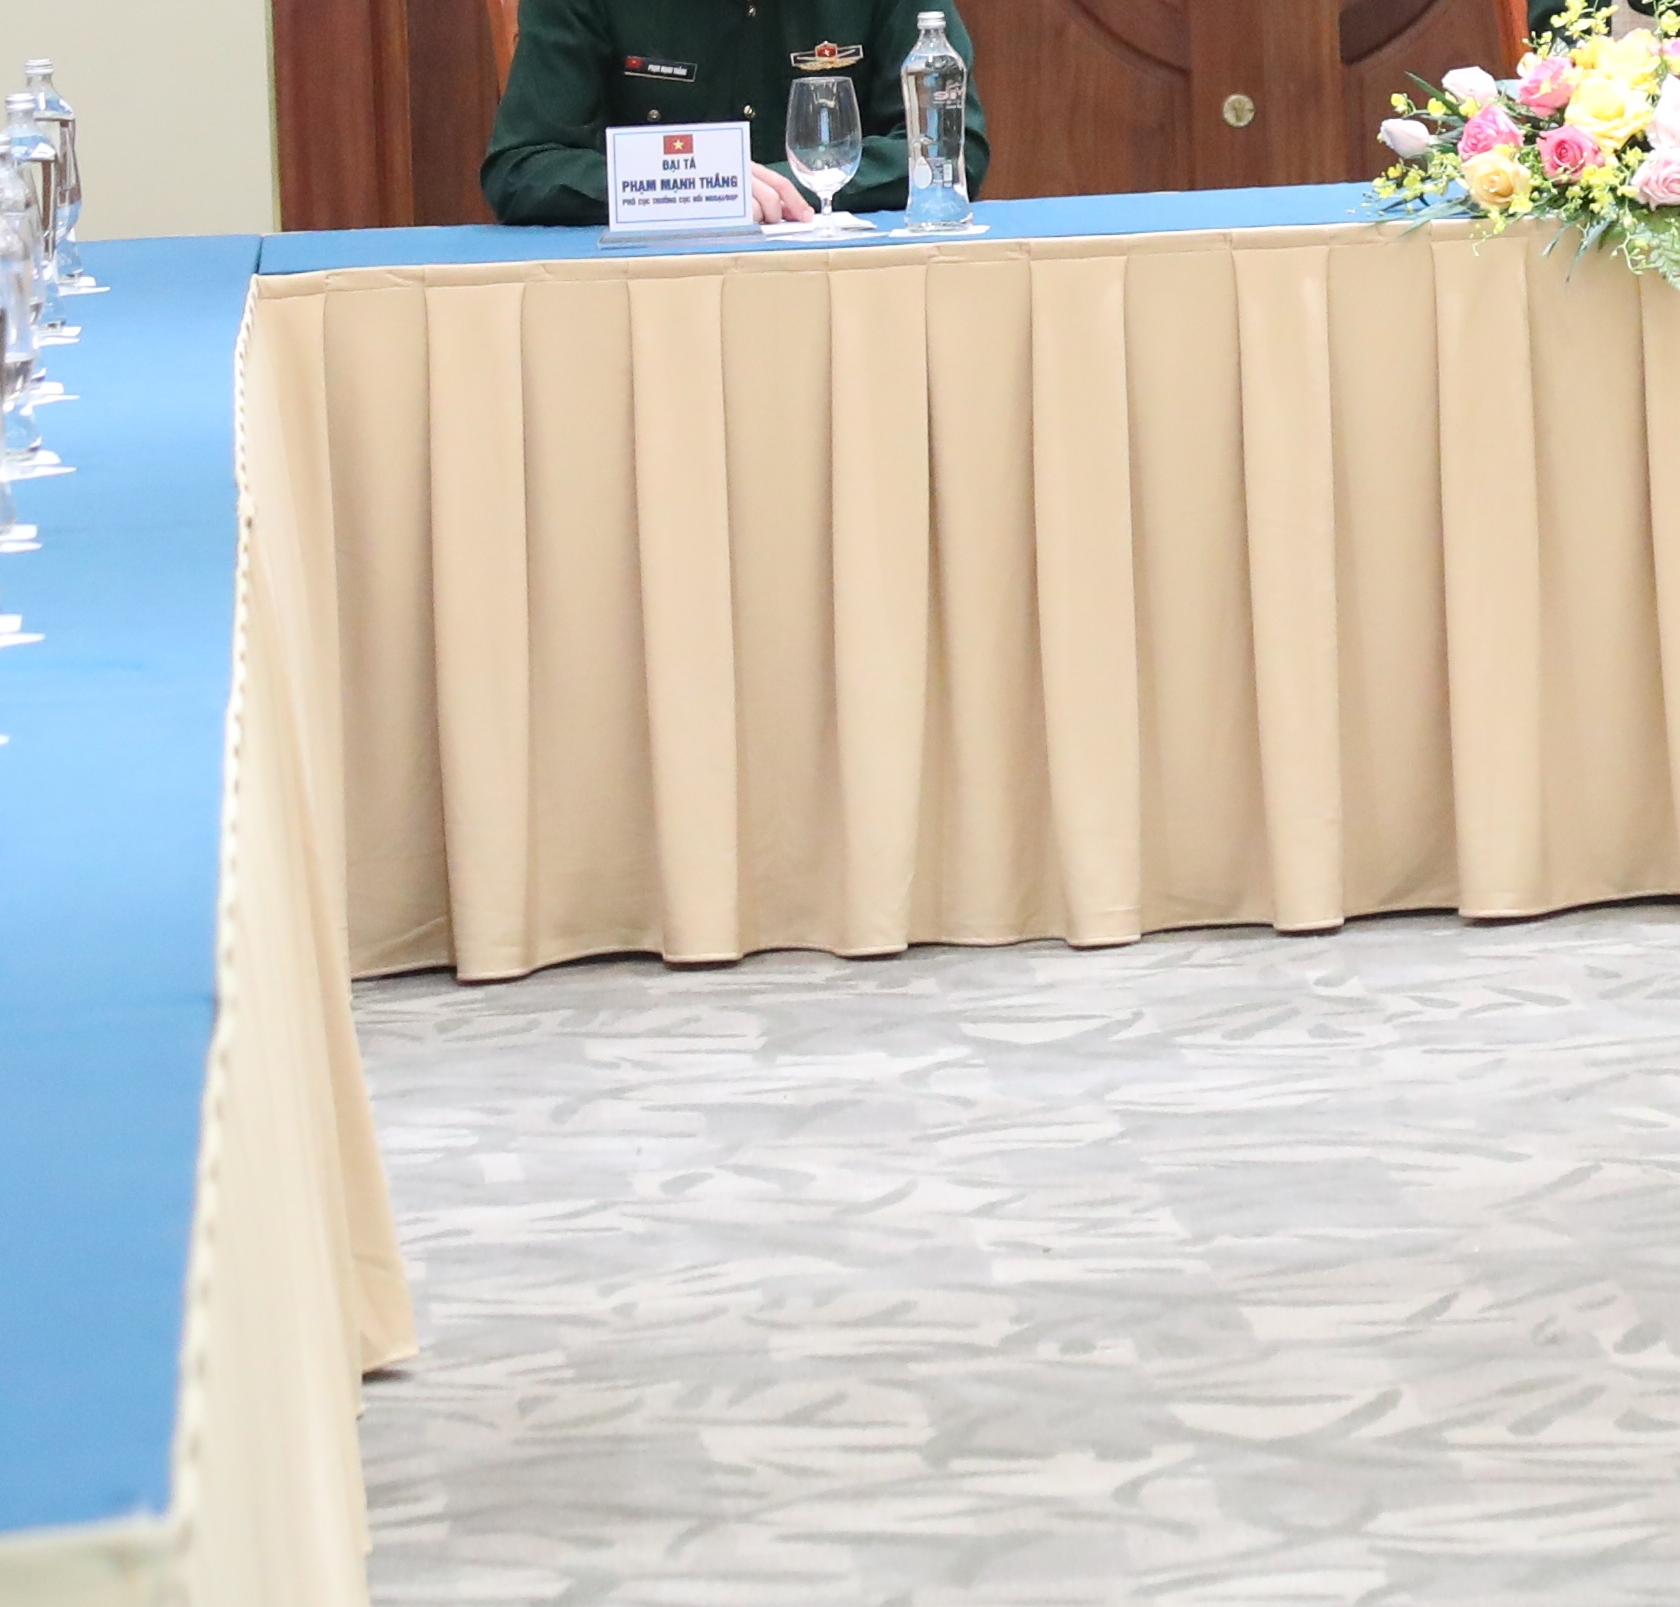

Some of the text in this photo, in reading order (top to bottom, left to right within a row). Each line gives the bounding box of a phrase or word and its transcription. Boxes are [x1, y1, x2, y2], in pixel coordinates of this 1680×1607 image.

[662, 157, 696, 172] ĐẠI TÁ
[622, 172, 738, 195] PHẠM MẠNH THẮNG
